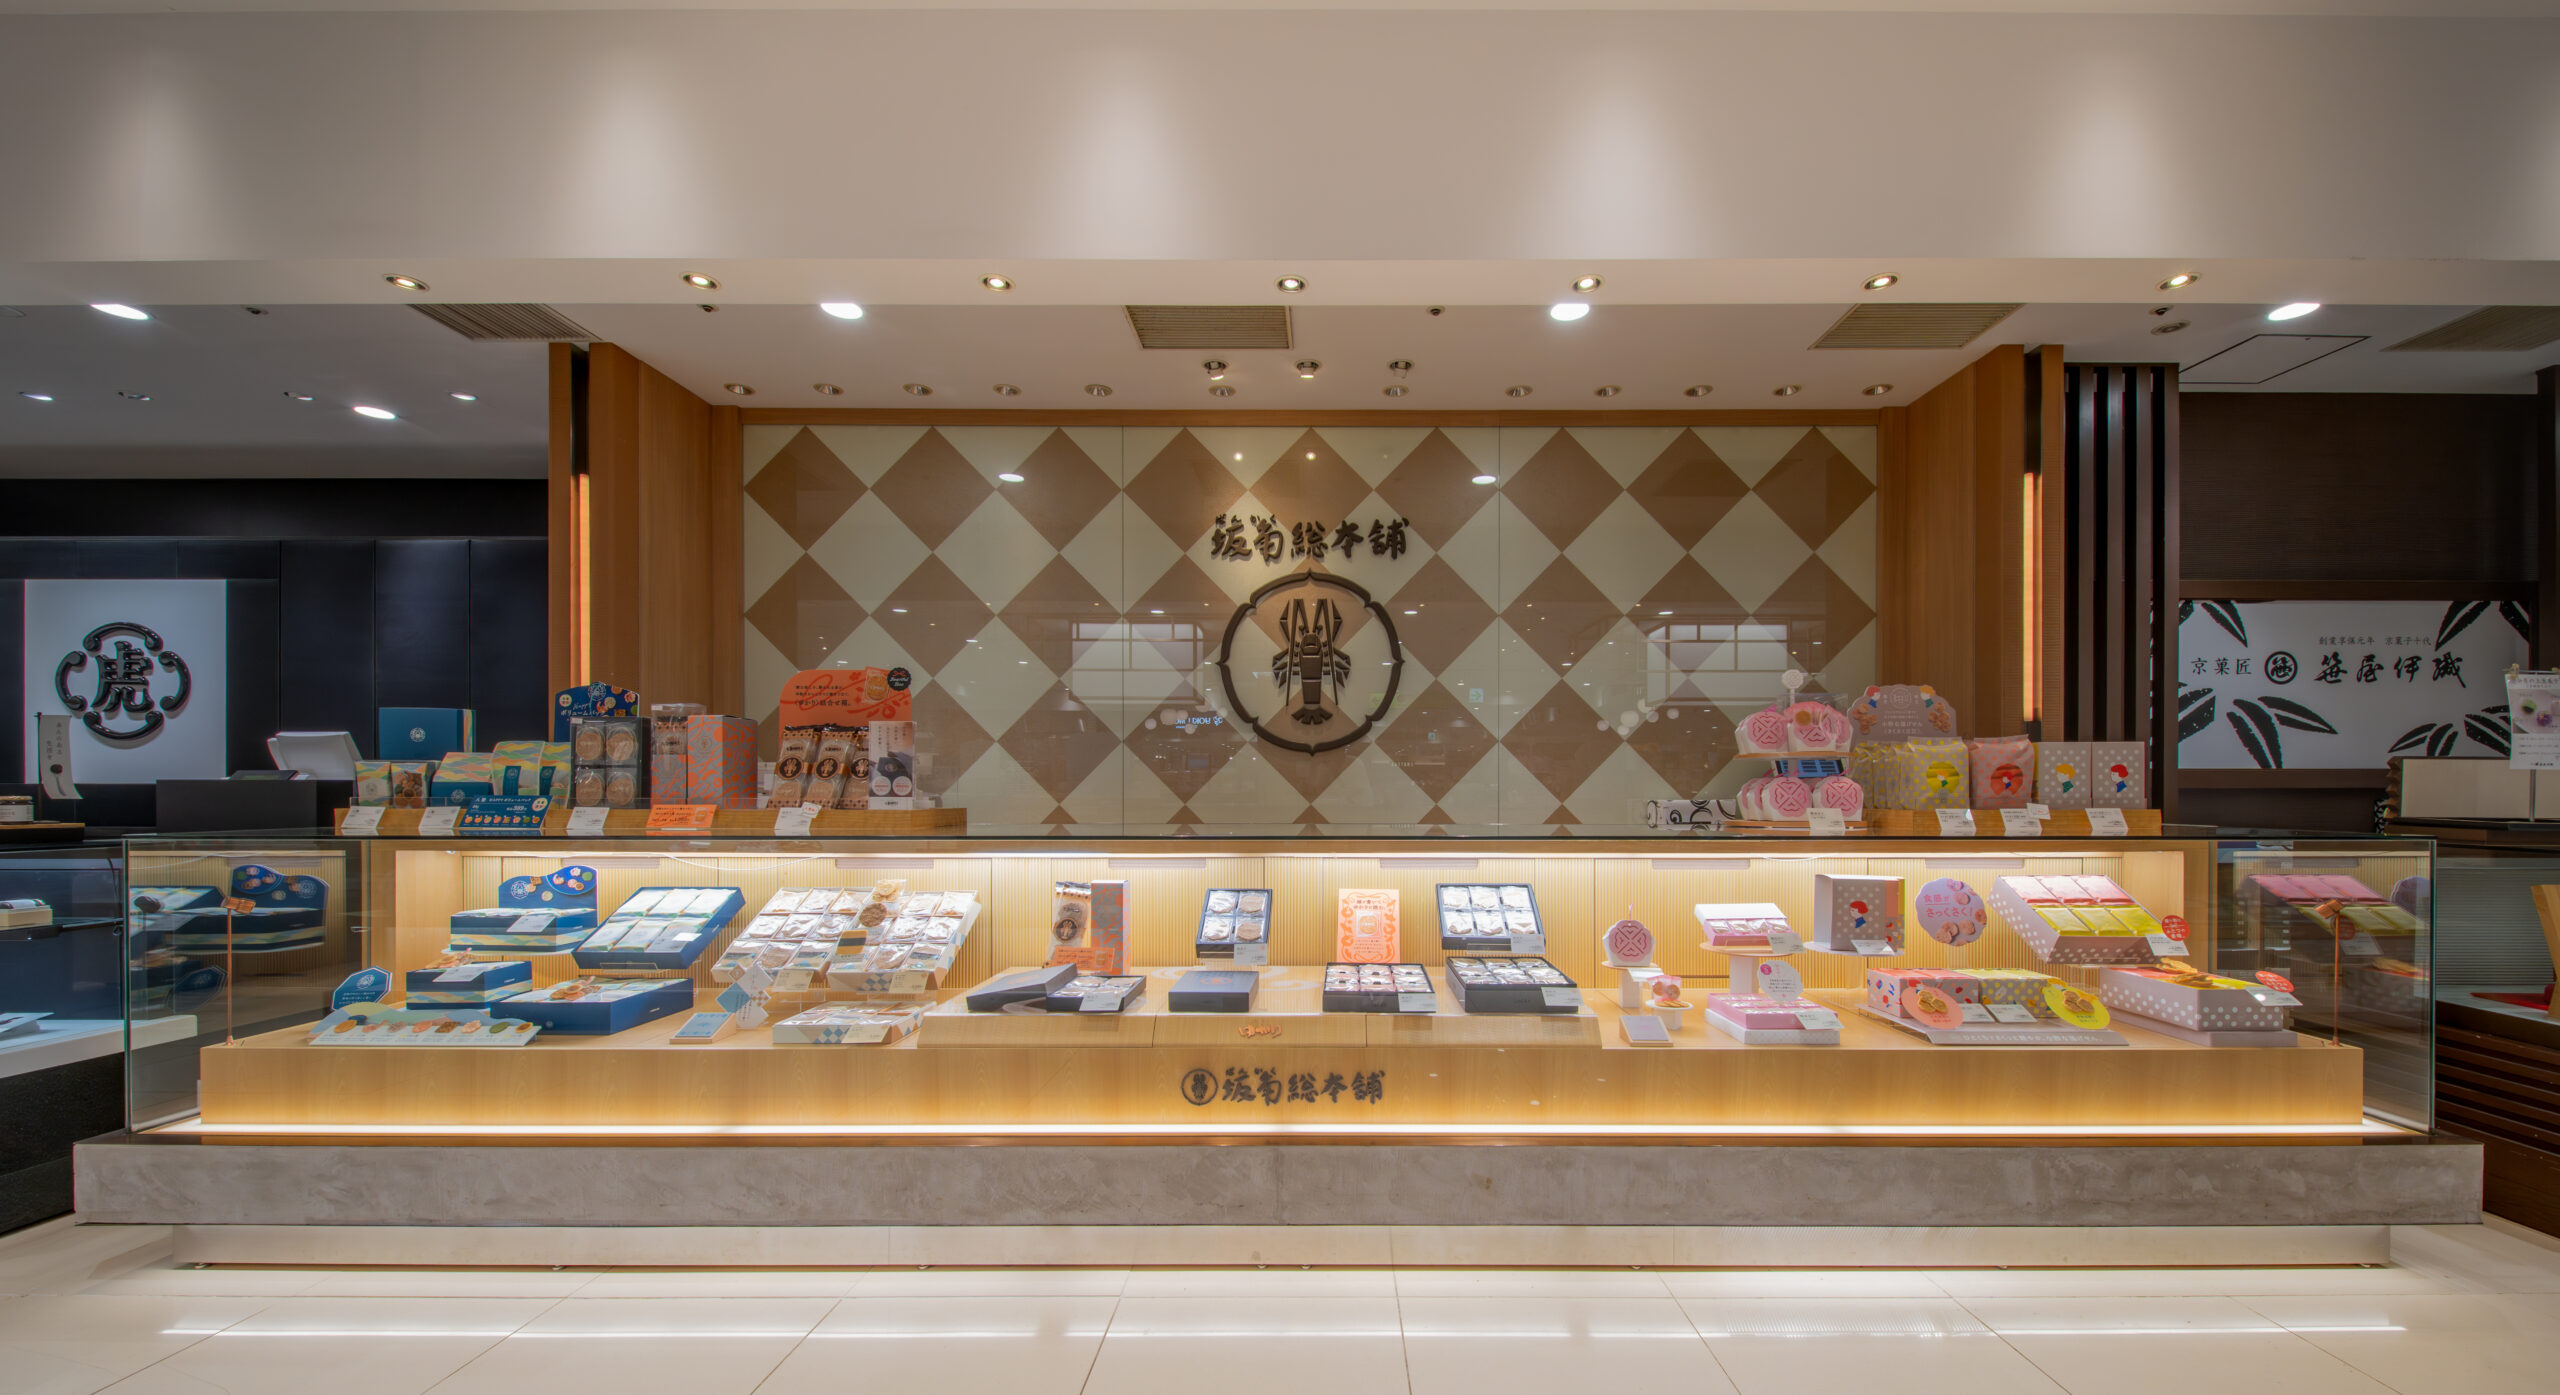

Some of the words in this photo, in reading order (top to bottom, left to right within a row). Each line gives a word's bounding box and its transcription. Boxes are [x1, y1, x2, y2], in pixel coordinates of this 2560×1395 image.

[2318, 635, 2376, 646] 創業享保元年
[2384, 635, 2432, 646] 京菓子十代
[2190, 657, 2253, 676] 京菓匠
[91, 640, 154, 713] 虎
